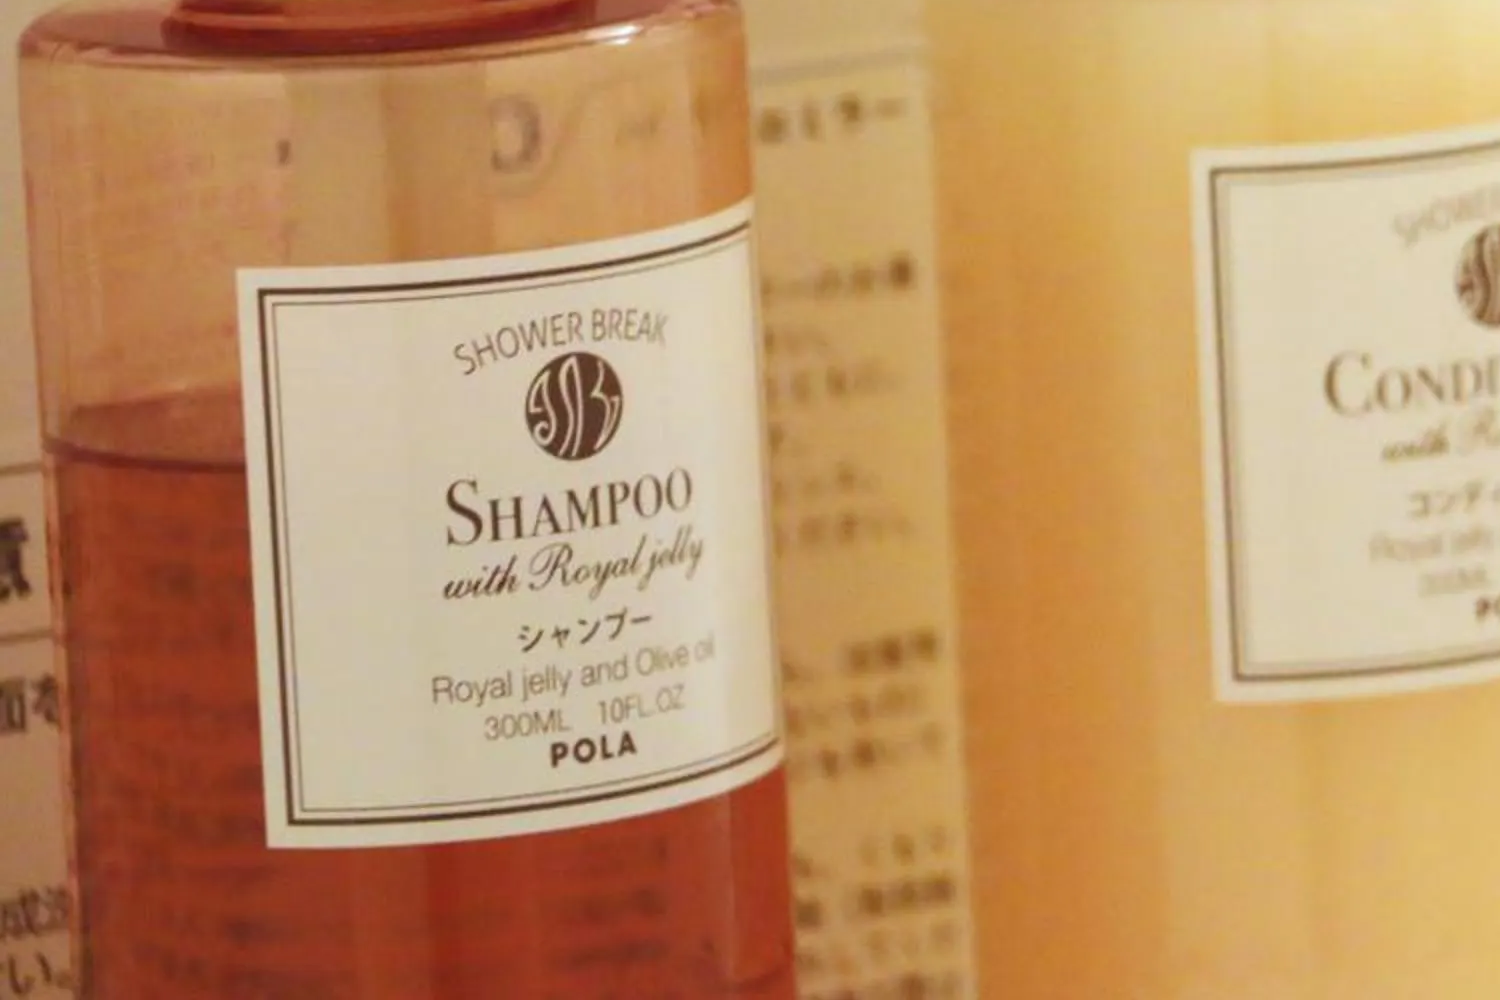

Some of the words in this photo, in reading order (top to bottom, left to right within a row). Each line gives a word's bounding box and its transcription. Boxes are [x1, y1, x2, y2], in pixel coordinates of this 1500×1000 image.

[453, 311, 584, 376] SHOWER
[591, 308, 669, 349] BREAK
[445, 466, 693, 547] SHAMPOO
[442, 555, 520, 600] with
[528, 532, 648, 600] Royal
[636, 524, 704, 593] jelly
[517, 606, 653, 653] シャンプー
[432, 669, 513, 708] Royal
[520, 664, 574, 702] jelly
[581, 653, 629, 688] and
[636, 643, 690, 678] Olive
[484, 707, 574, 742] 300ML
[551, 731, 637, 768] POLA
